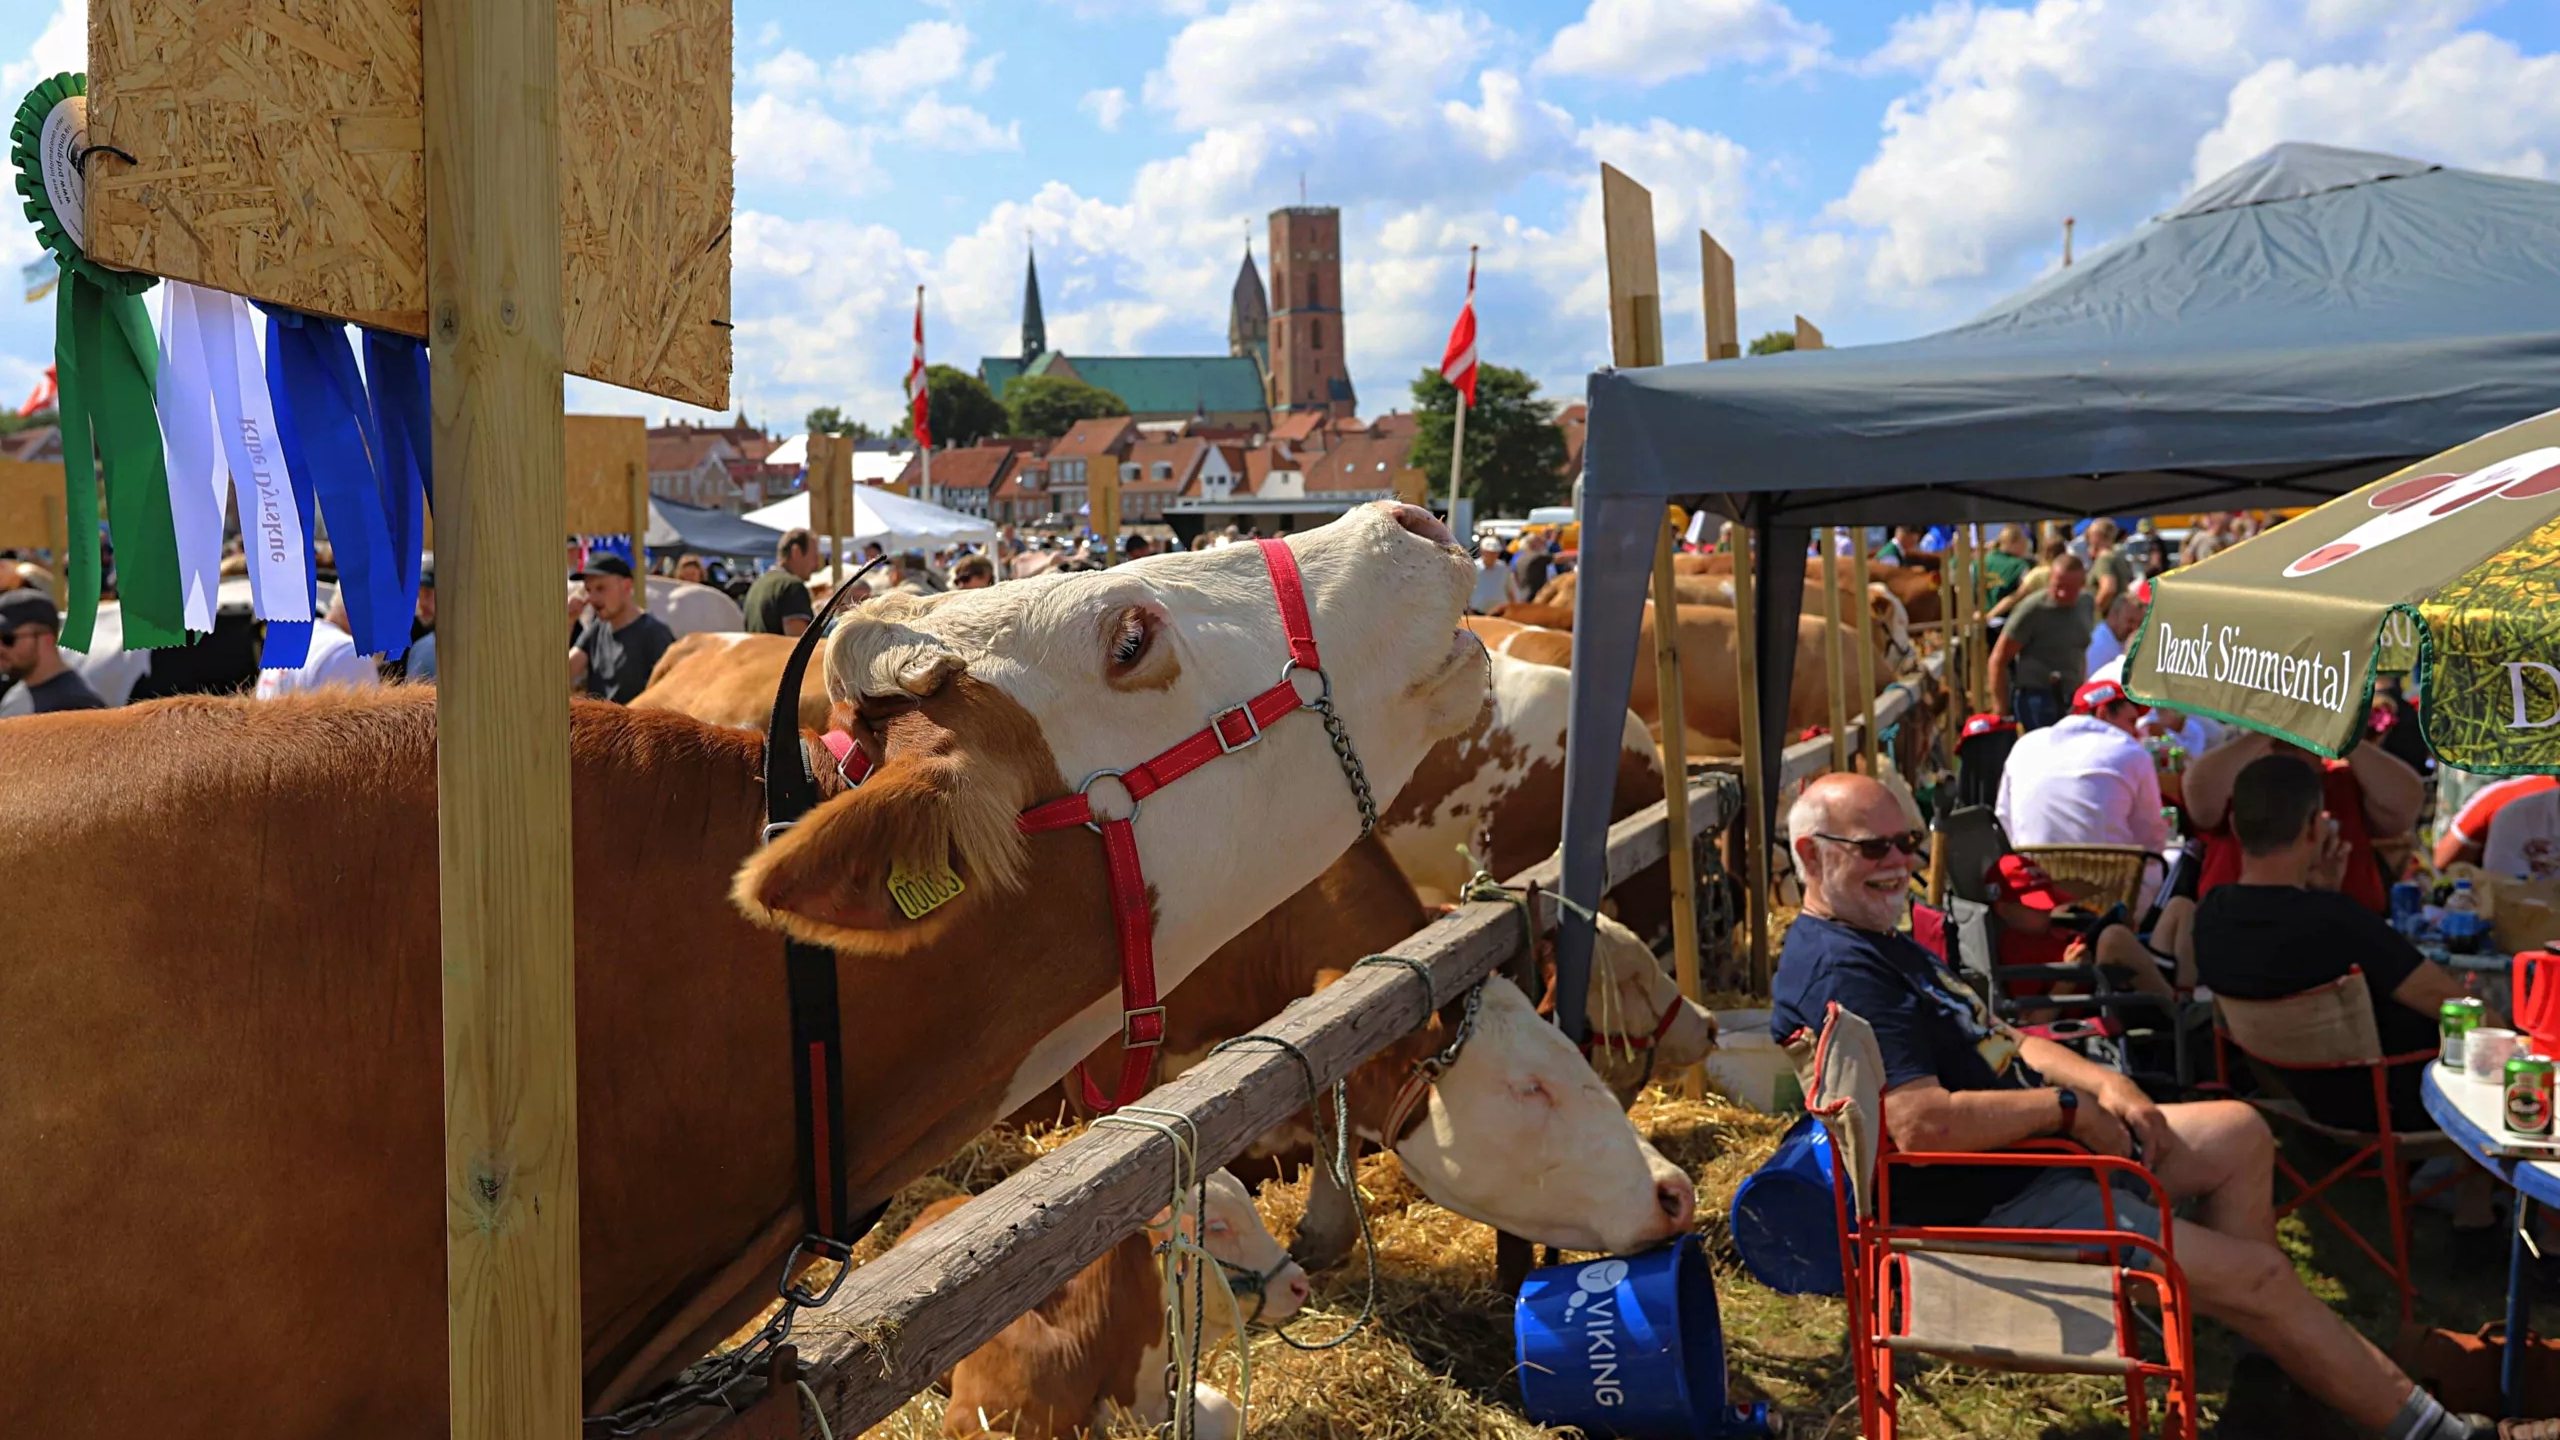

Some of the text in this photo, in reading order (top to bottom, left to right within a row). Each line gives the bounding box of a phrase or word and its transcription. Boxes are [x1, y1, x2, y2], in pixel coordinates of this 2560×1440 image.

[2156, 622, 2351, 713] Dansk Simmental
[1586, 1297, 1624, 1407] VIKING
